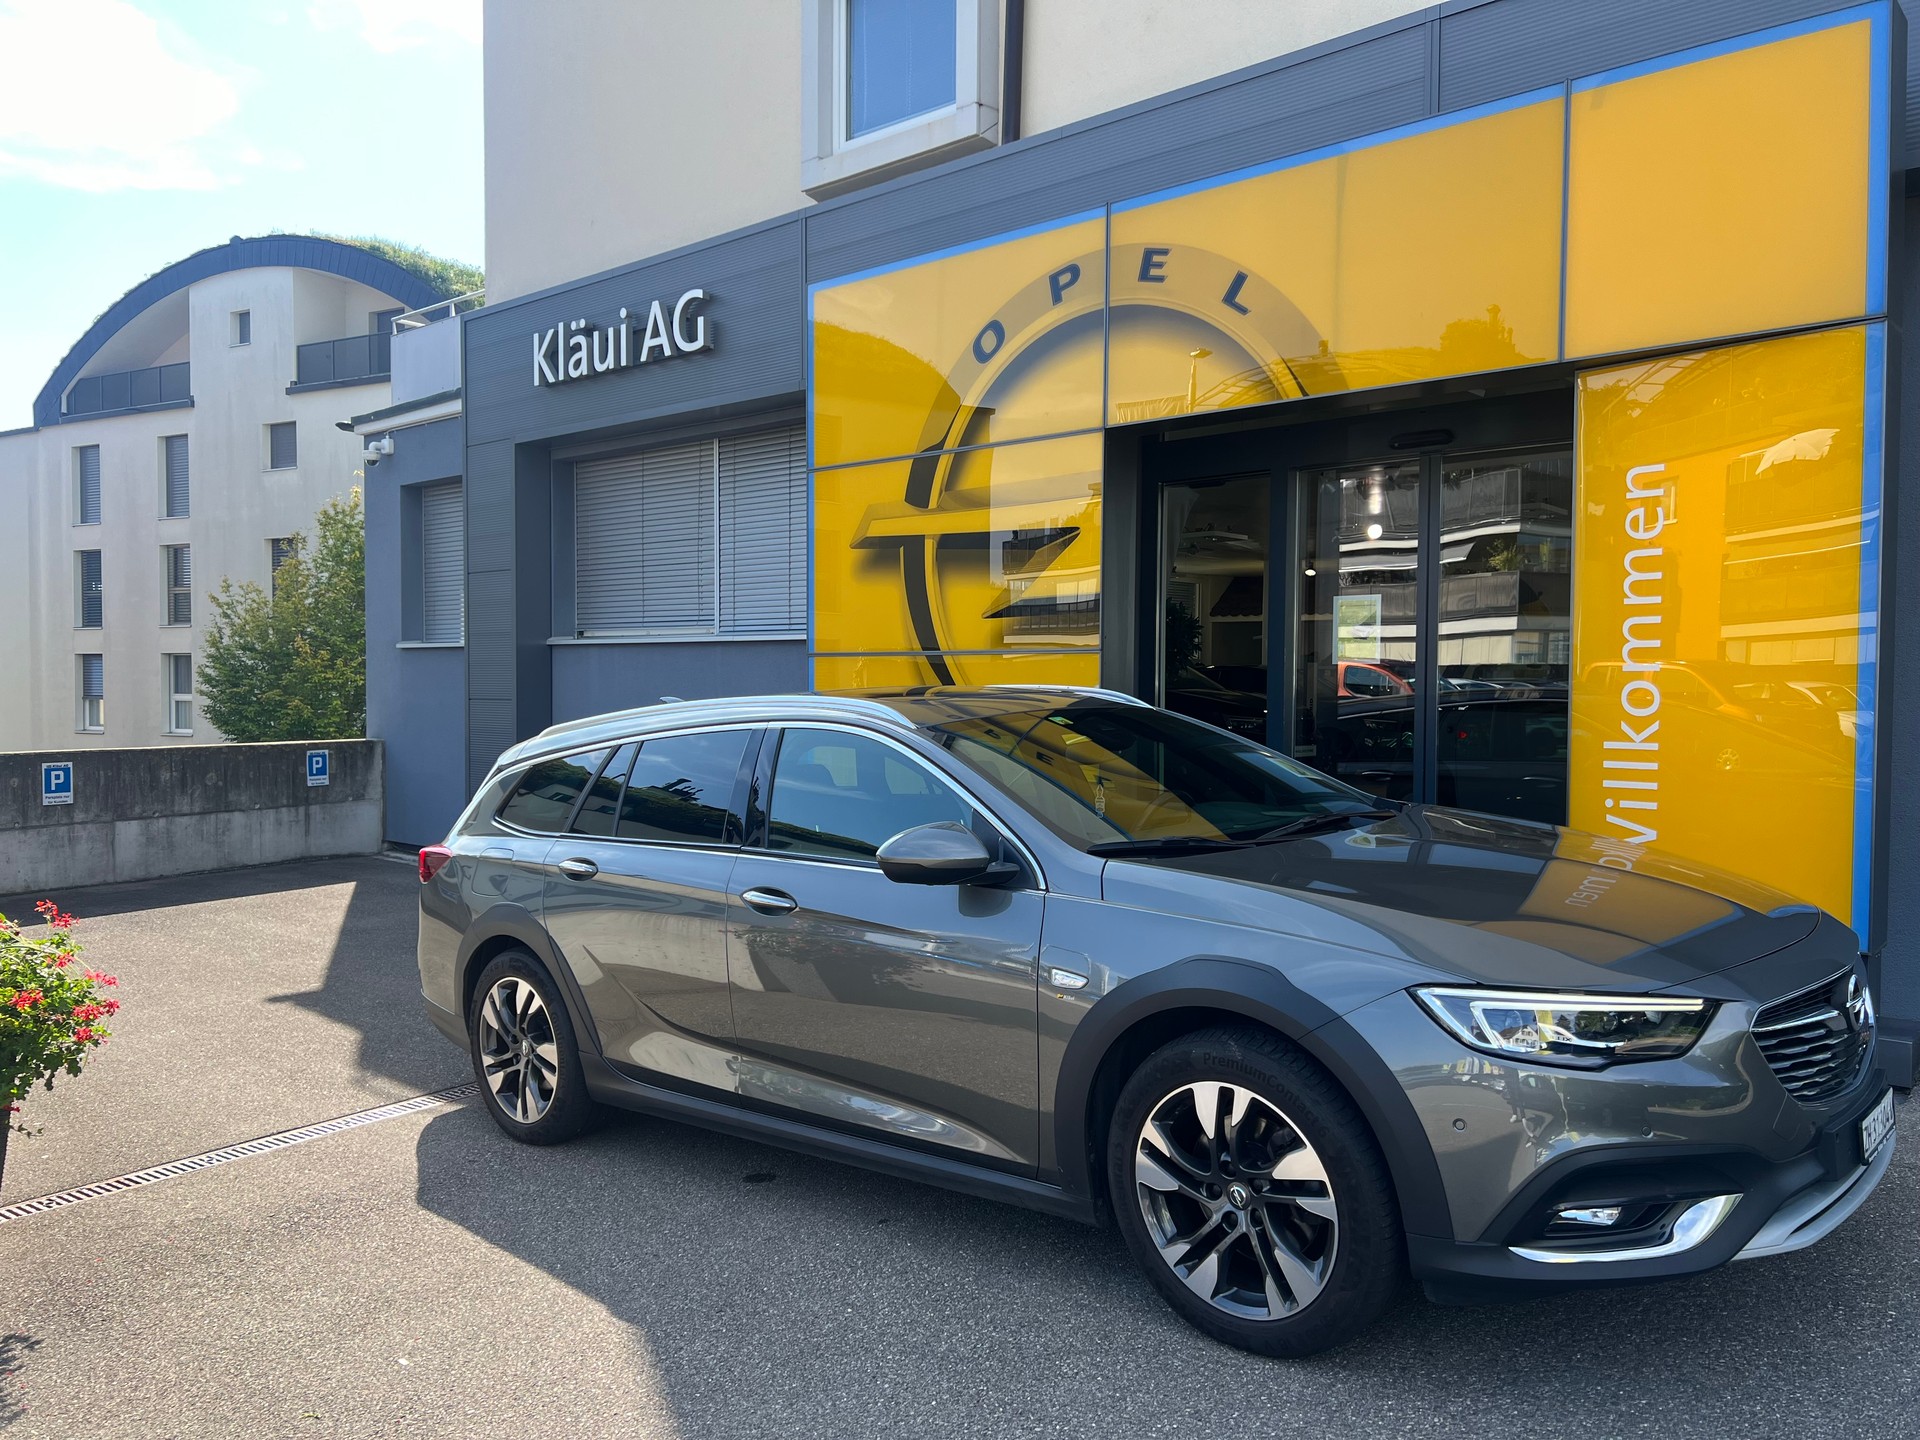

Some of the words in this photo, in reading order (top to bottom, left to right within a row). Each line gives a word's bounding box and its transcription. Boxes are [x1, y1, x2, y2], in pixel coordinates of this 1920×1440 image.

[973, 247, 1251, 364] OPEL
[533, 307, 628, 386] Kläui
[640, 289, 706, 362] AG
[51, 770, 64, 791] P
[313, 757, 322, 774] P
